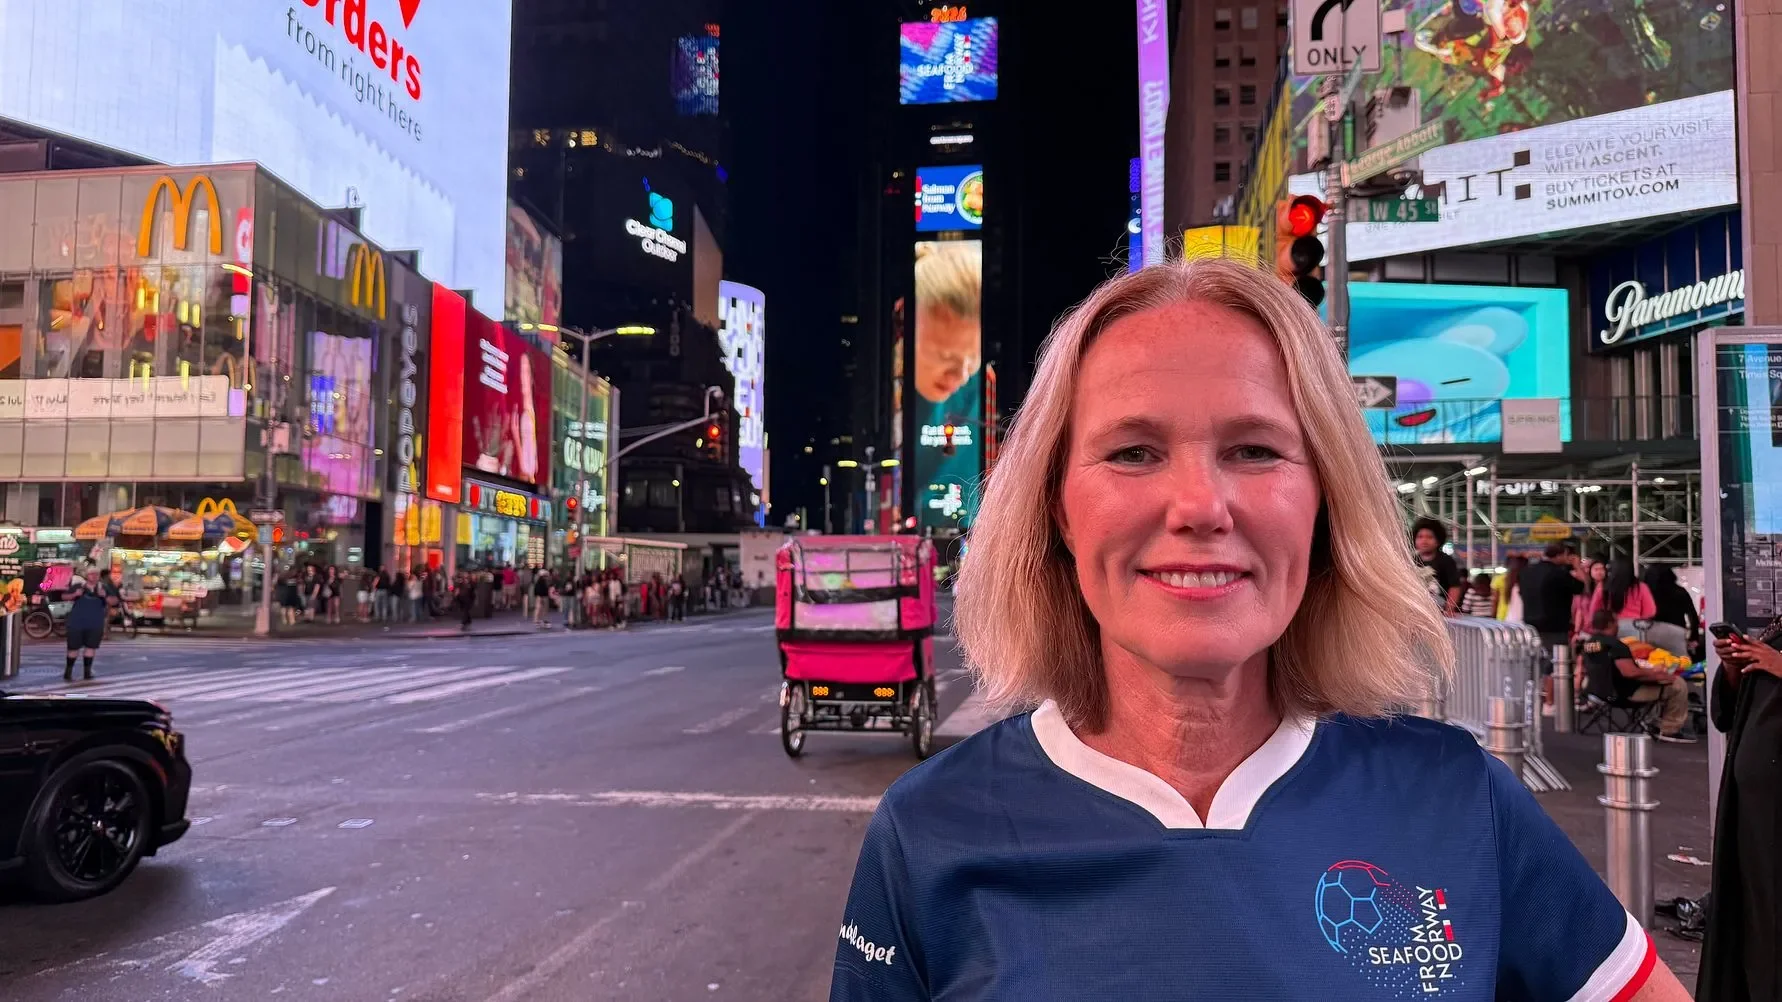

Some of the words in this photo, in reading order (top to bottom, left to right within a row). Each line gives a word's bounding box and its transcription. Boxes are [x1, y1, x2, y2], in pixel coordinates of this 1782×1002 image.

[302, 0, 422, 101] rders
[1307, 44, 1367, 66] ONLY
[287, 7, 335, 72] from
[341, 57, 384, 112] right
[388, 91, 423, 141] here
[1545, 138, 1615, 160] ELEVATE
[1620, 128, 1666, 146] YOUR
[1669, 119, 1713, 137] VISIT
[1545, 157, 1585, 174] WITH
[1590, 145, 1663, 168] ASCENT.
[1546, 180, 1577, 196] BUY
[1582, 167, 1652, 190] TICKETS
[1656, 163, 1677, 176] AT
[1546, 179, 1679, 210] SUMMITOV.COM
[1372, 201, 1389, 221] W
[1396, 201, 1418, 221] 45
[1738, 354, 1745, 363] 7
[1354, 386, 1380, 399] AY
[1415, 885, 1453, 979] NORWAY
[1368, 943, 1463, 965] SEAFOOD
[1409, 924, 1439, 993] FROM
